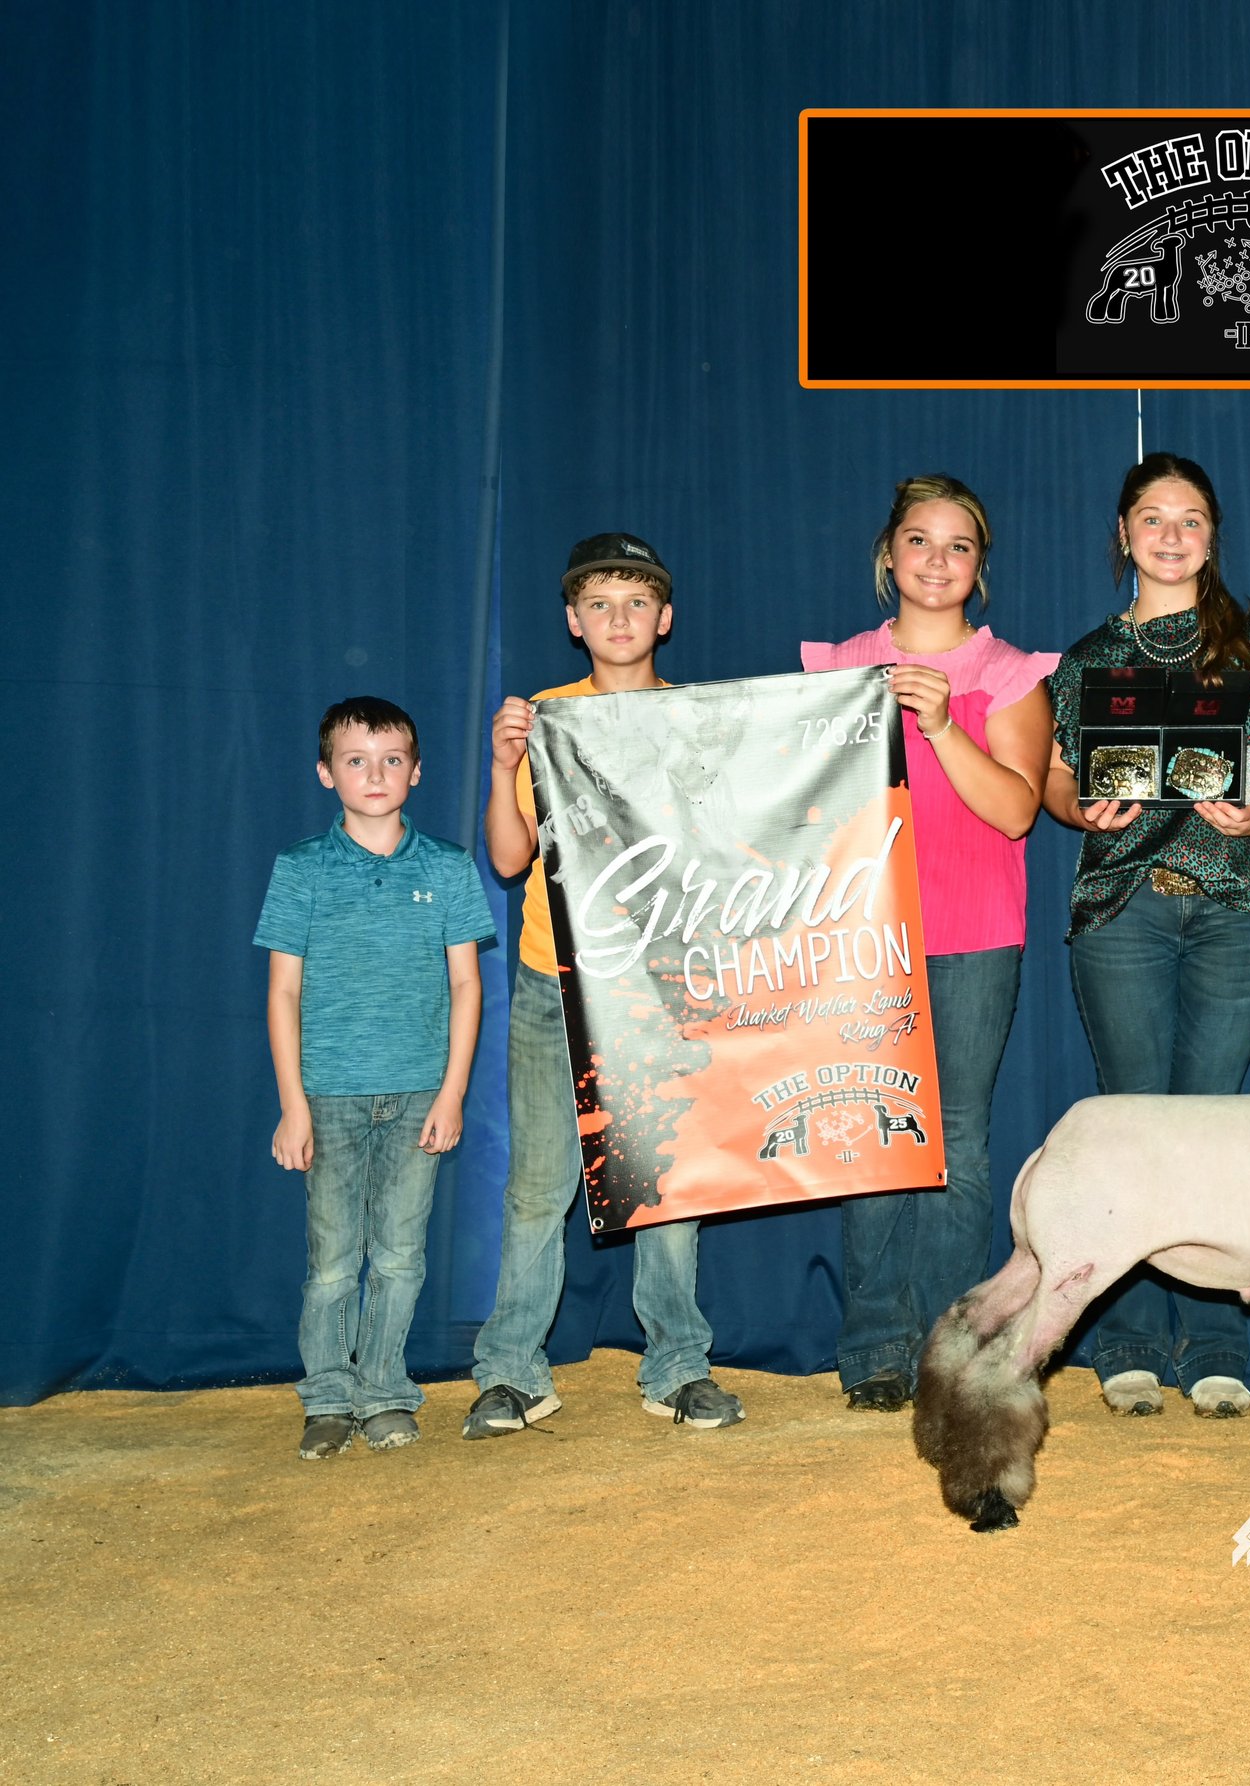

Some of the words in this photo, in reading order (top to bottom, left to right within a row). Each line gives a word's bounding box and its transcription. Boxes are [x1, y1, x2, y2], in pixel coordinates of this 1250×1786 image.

[797, 712, 882, 749] 7.26.25
[574, 816, 903, 979] Grand
[683, 922, 912, 1000] CHAMPION
[727, 1002, 793, 1030] Market
[795, 993, 856, 1023] Wether
[864, 986, 912, 1015] Lamb
[752, 1072, 809, 1110] THE
[816, 1063, 921, 1094] OPTION
[775, 1130, 795, 1142] 20
[889, 1118, 908, 1130] 25
